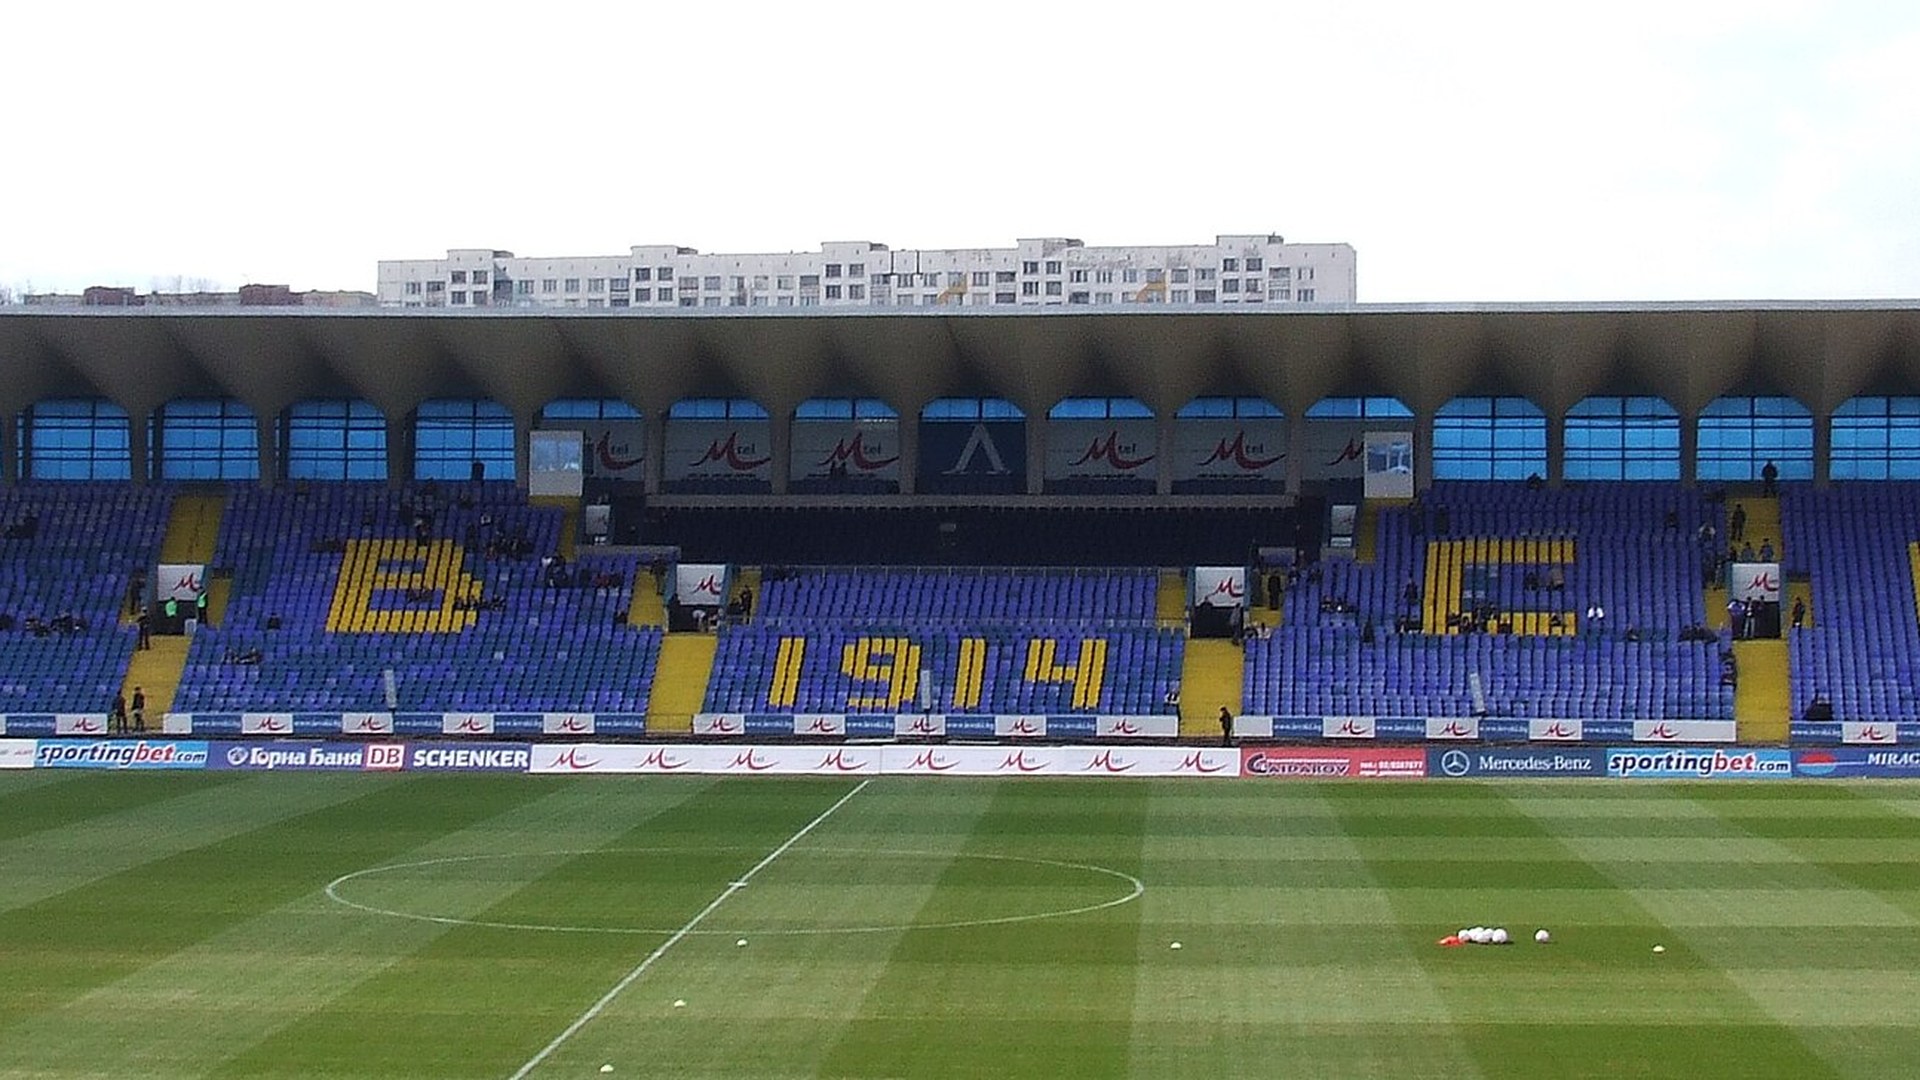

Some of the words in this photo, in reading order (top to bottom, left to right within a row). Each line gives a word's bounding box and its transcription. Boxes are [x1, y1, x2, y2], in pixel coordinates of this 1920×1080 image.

[768, 637, 1107, 709] 1914
[37, 741, 208, 765] sportingbet.com
[250, 747, 306, 769] Горна
[309, 747, 363, 766] Баня
[366, 747, 400, 764] DB
[413, 750, 528, 767] SCHENKER
[1478, 755, 1592, 771] Mercedes-Benz
[1609, 751, 1789, 776] sportingbet.com
